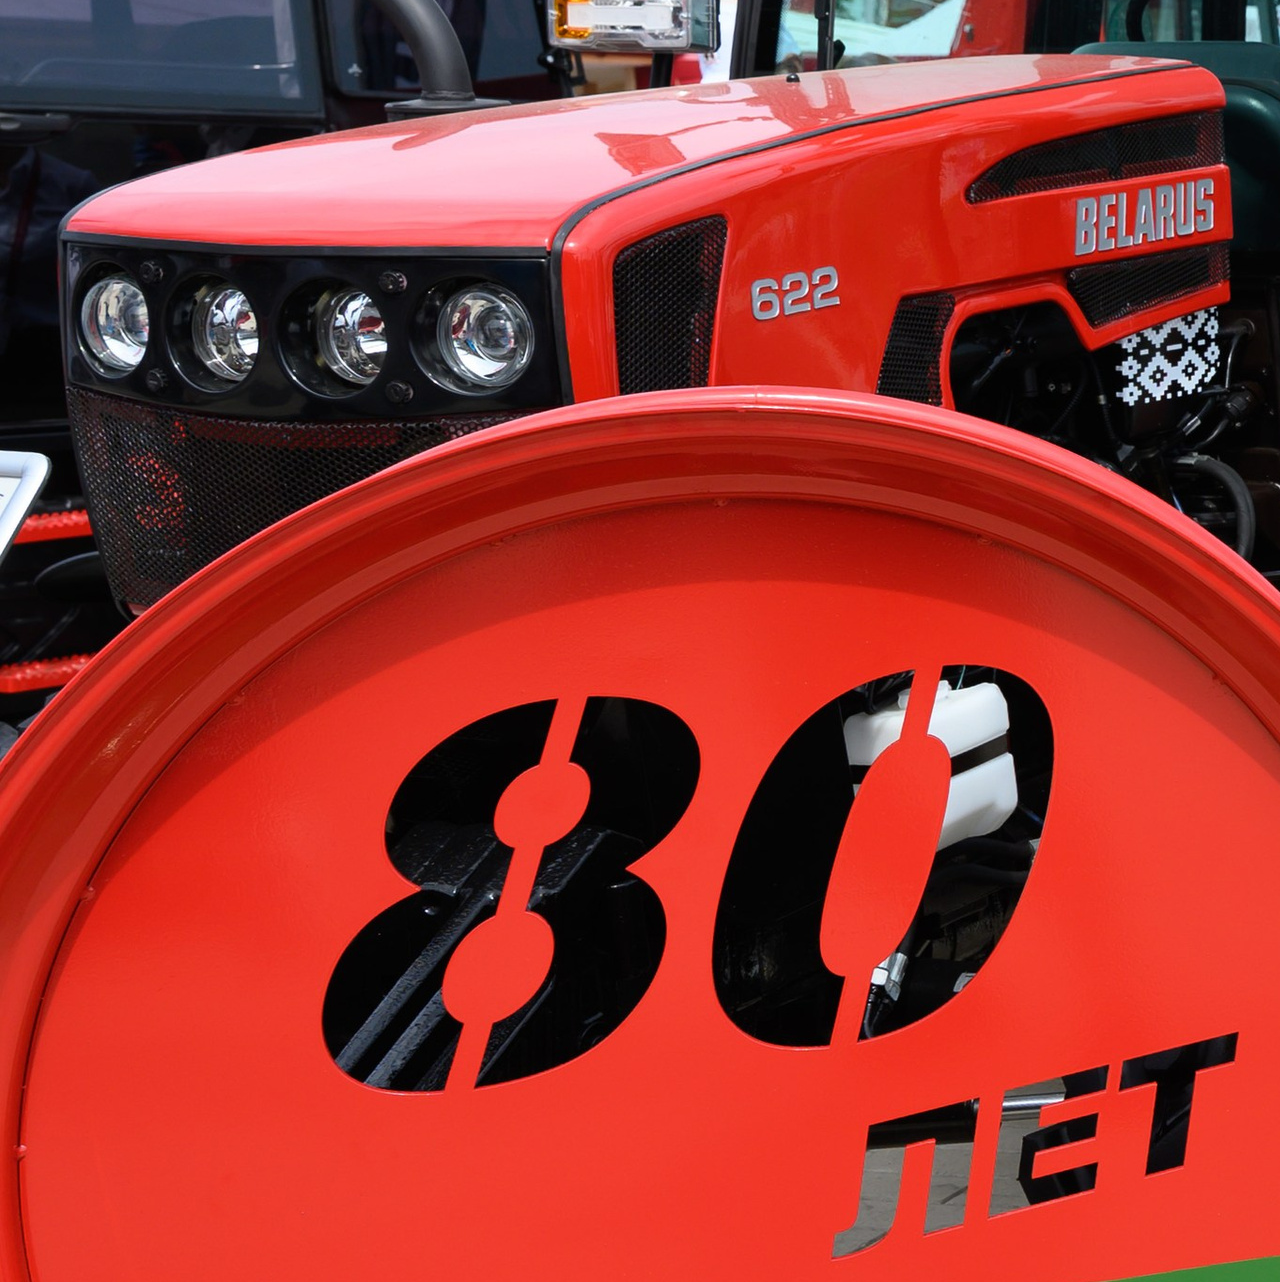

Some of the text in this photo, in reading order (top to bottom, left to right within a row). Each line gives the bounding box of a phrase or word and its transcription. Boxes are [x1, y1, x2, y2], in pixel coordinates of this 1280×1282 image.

[751, 265, 840, 321] 622
[1074, 178, 1214, 256] BELARUS
[321, 664, 1055, 1095] 80
[831, 1031, 1239, 1261] ЛЕТ
